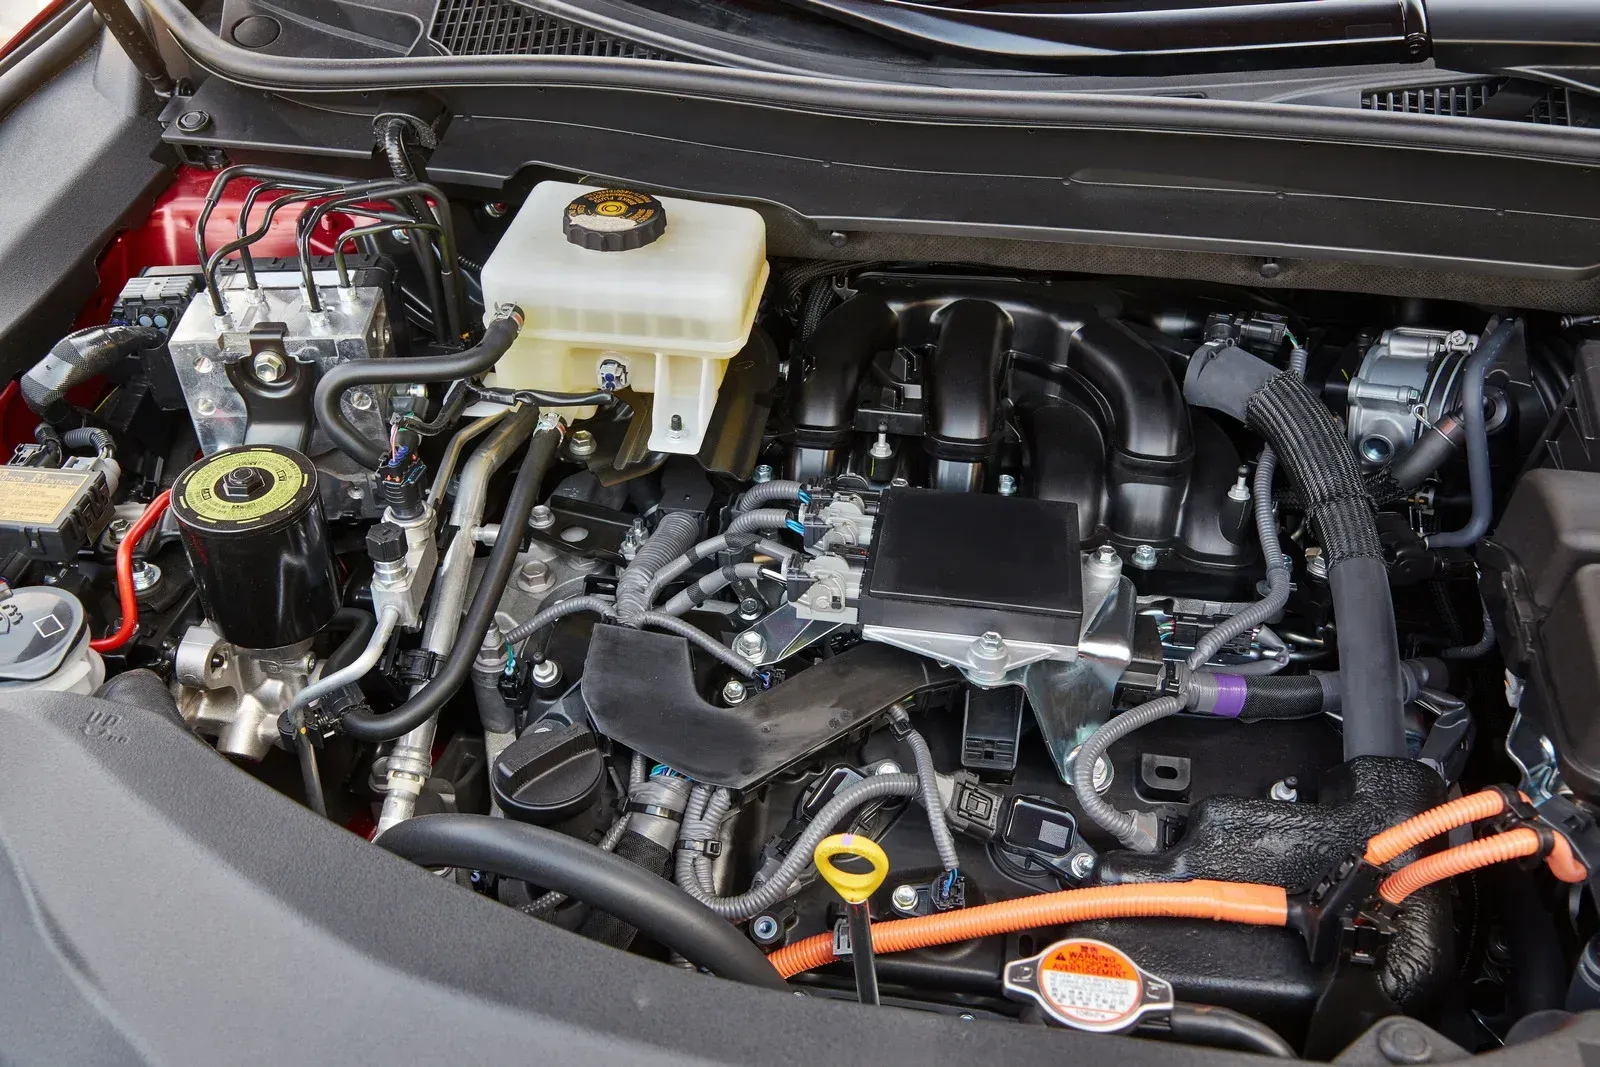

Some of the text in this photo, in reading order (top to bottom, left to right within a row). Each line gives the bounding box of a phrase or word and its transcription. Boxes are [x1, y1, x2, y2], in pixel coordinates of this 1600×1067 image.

[32, 477, 74, 485] ATTENTION
[1069, 952, 1116, 963] WARNING
[1053, 963, 1127, 977] AVERTISSEMENT
